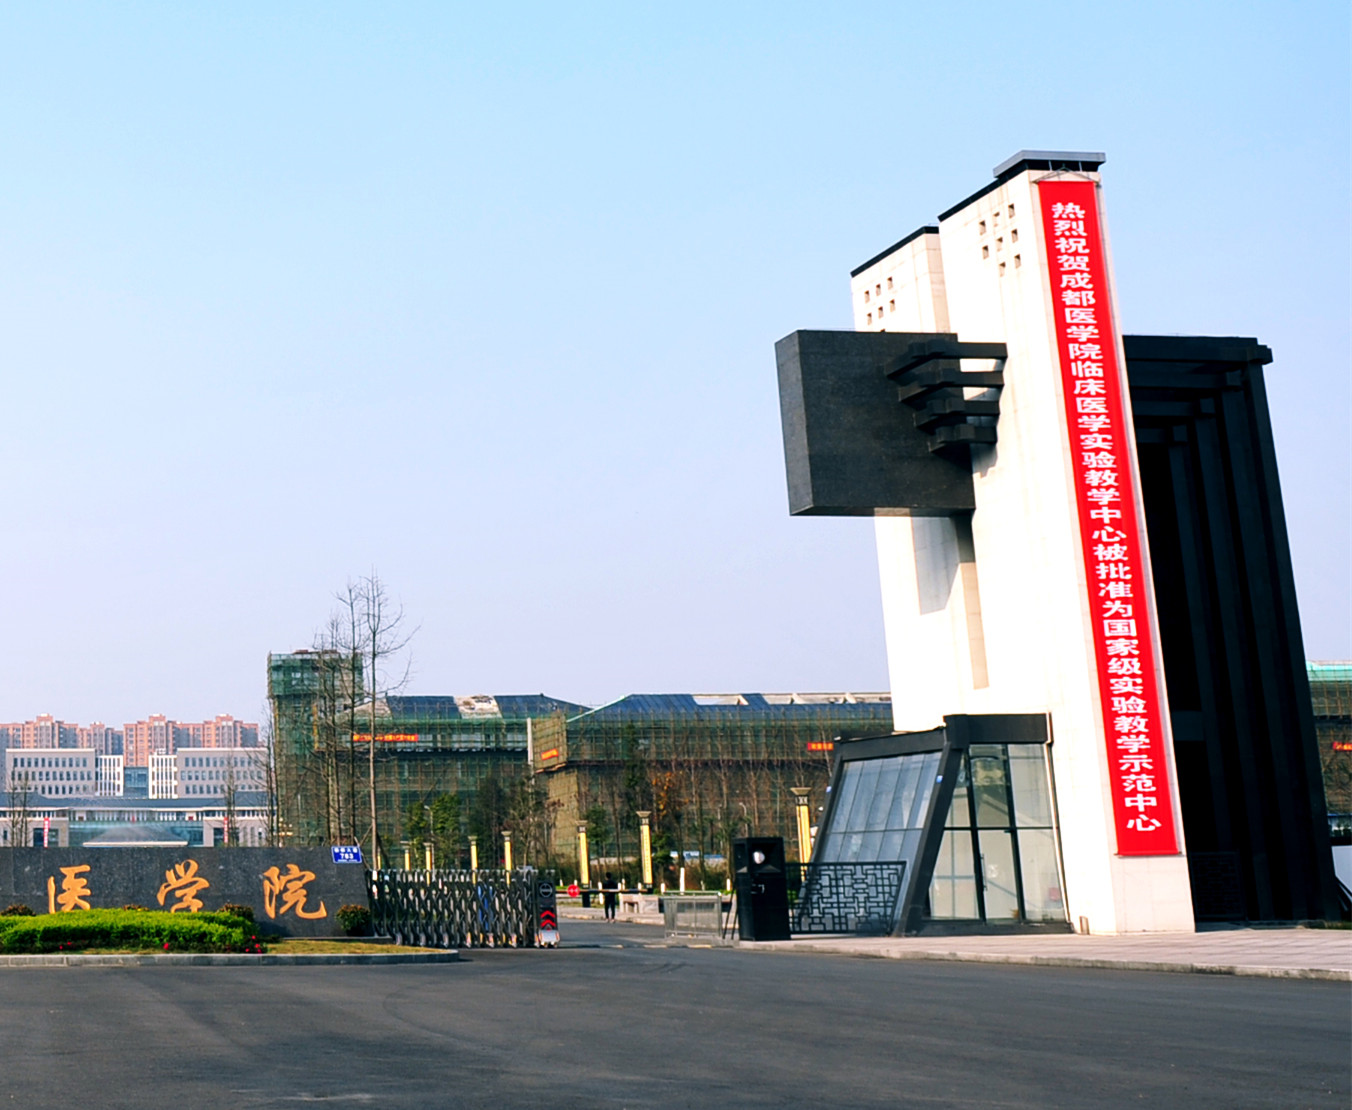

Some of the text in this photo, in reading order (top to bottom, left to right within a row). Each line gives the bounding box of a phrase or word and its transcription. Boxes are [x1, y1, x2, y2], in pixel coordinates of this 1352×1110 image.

[1051, 203, 1162, 832] 热烈祝贺成都医学院临床医学实验教学中心被批准为国家级实验教学示范中心
